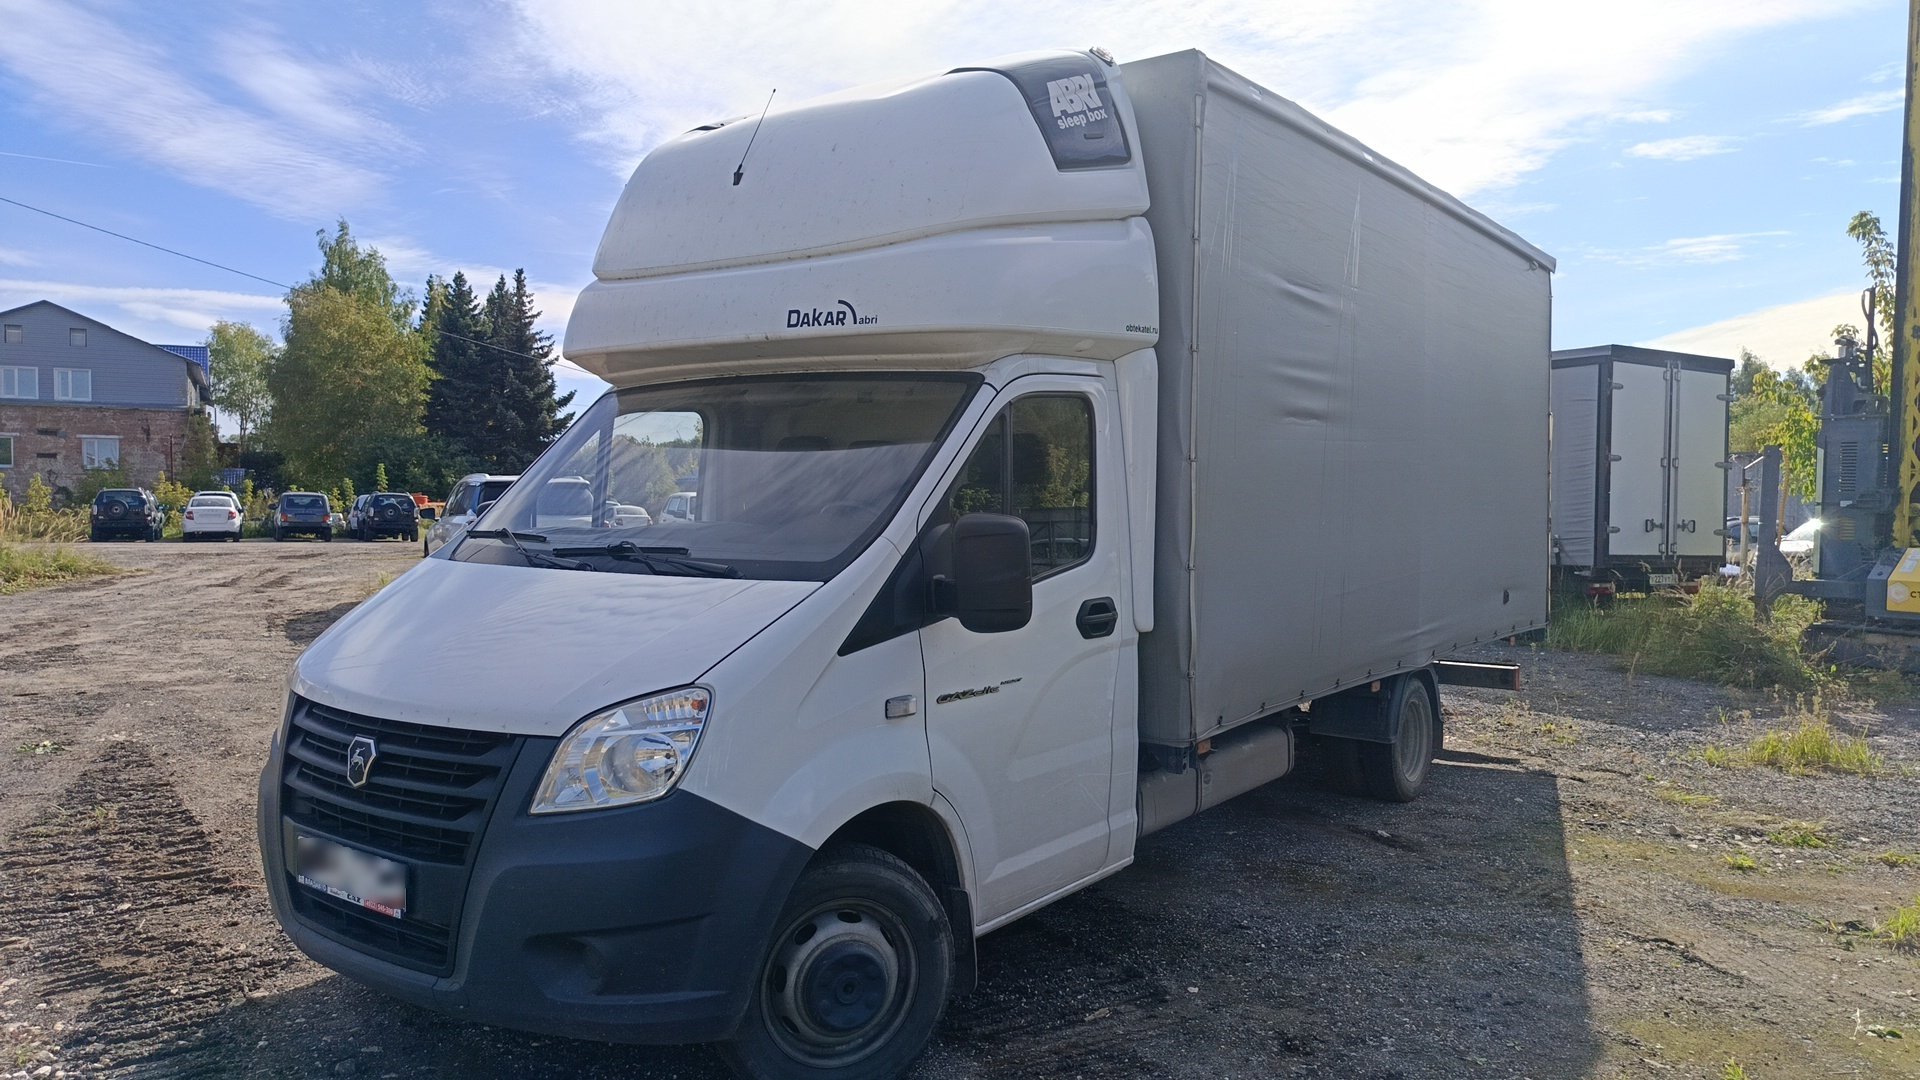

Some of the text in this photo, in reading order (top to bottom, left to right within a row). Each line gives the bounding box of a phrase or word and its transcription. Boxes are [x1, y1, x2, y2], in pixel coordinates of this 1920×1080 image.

[1046, 73, 1103, 118] ABRI
[1057, 108, 1108, 130] sleep box
[858, 314, 878, 325] abri
